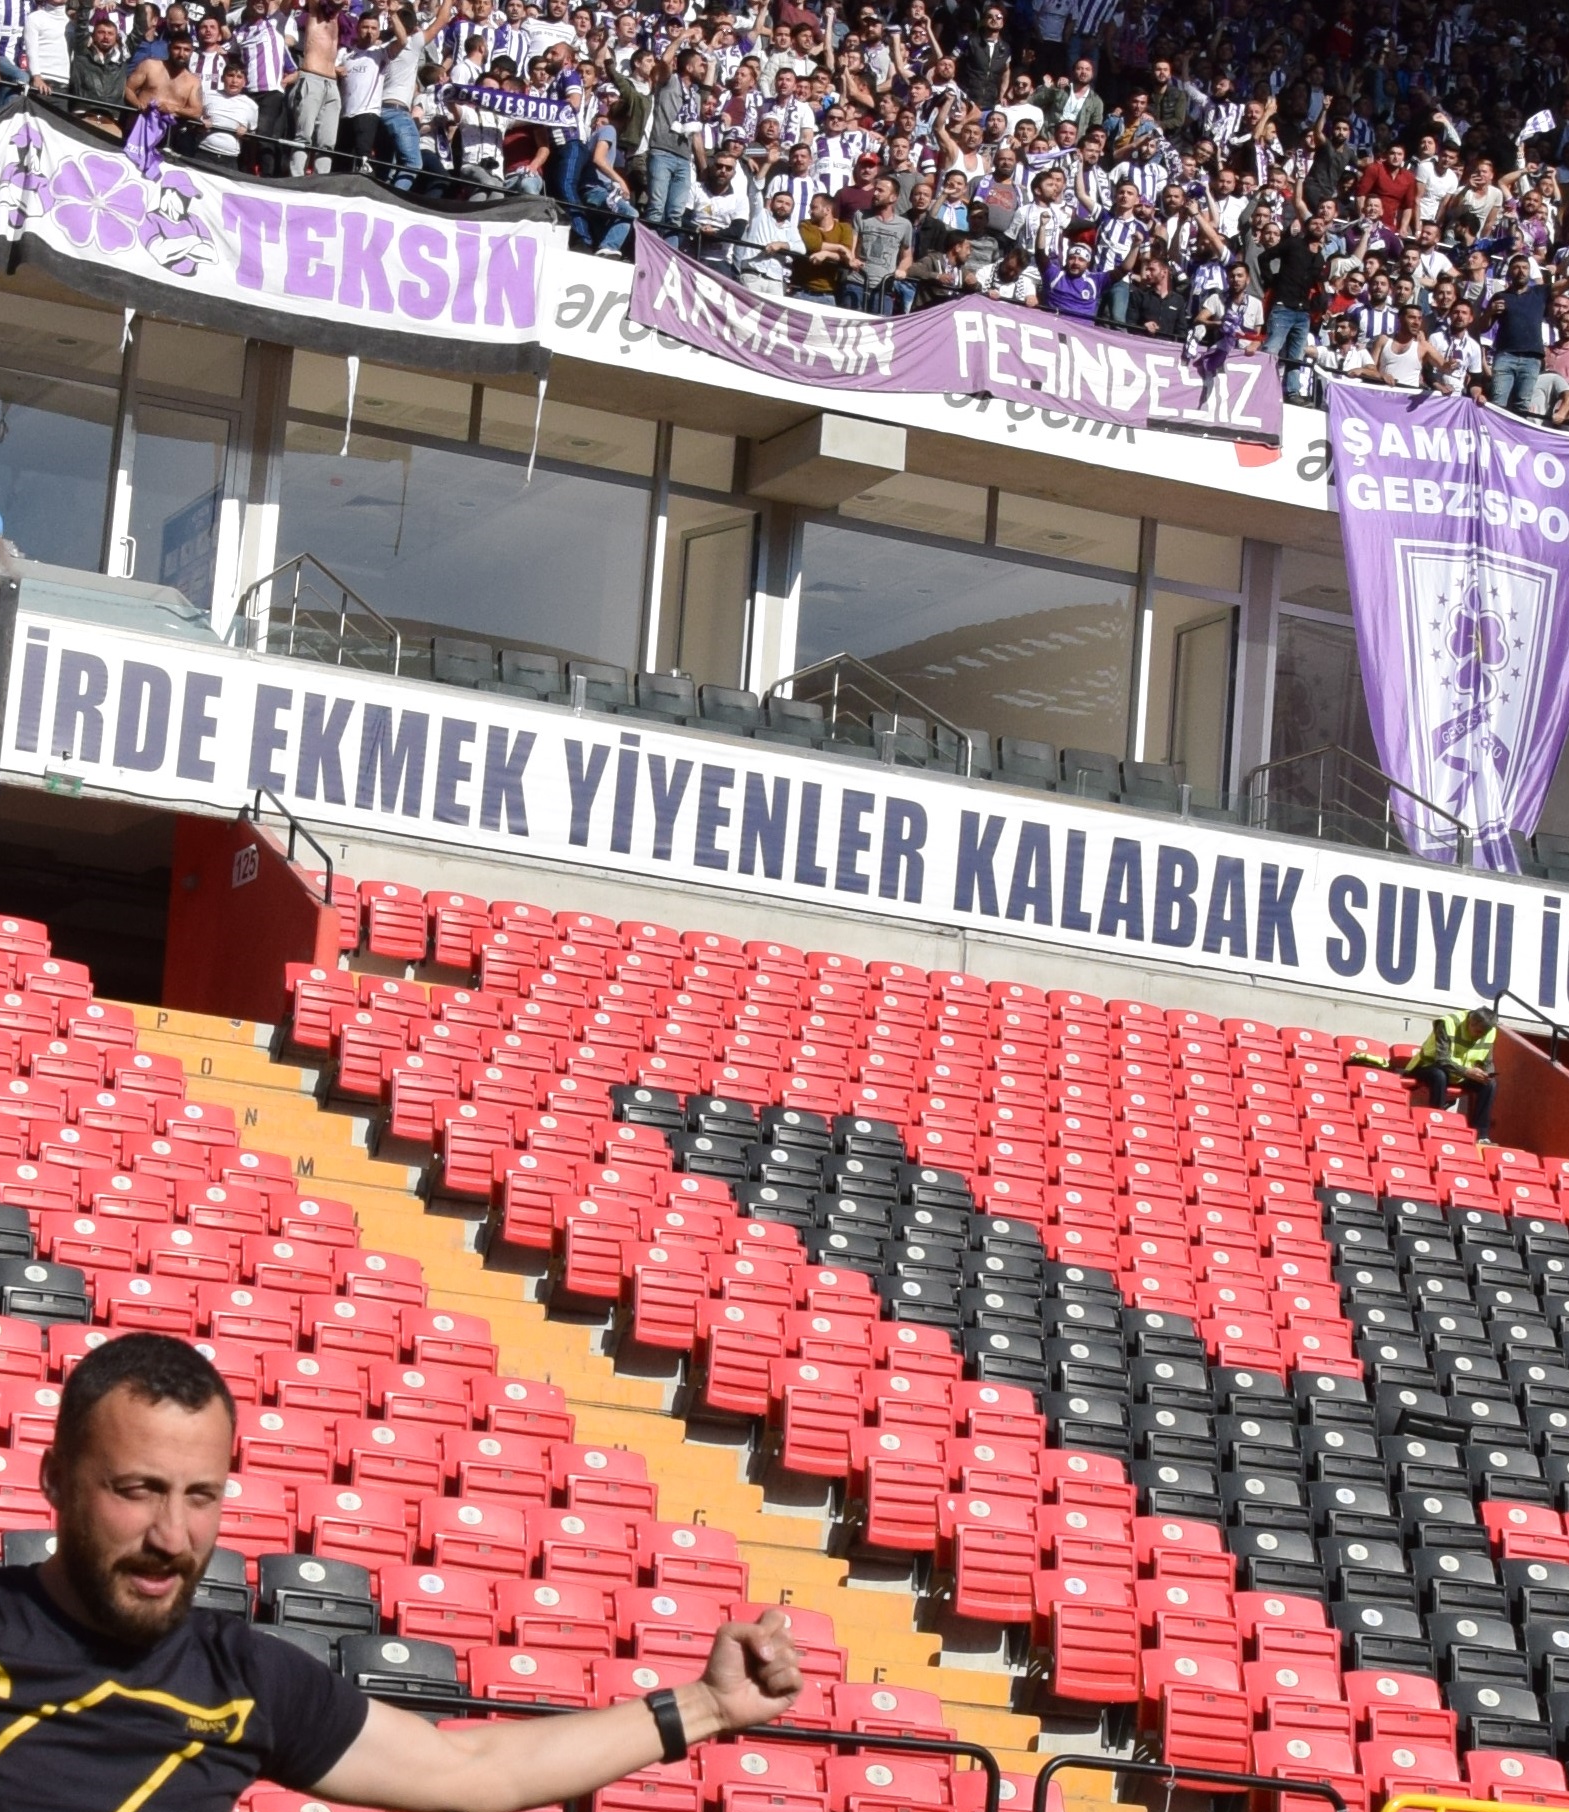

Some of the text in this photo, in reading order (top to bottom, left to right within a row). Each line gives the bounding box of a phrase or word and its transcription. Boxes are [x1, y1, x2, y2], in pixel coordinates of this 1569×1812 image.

[221, 192, 538, 329] TEKSİN
[246, 682, 538, 837] EKMEK
[563, 730, 930, 905] YİYENLER
[952, 809, 1305, 968] KALABAK
[1325, 874, 1515, 1001] SUYU
[1538, 895, 1569, 1009] İ
[339, 844, 349, 859] T
[235, 849, 258, 882] 125
[156, 1011, 169, 1029] P
[244, 1107, 258, 1127] N
[296, 1155, 315, 1177] M
